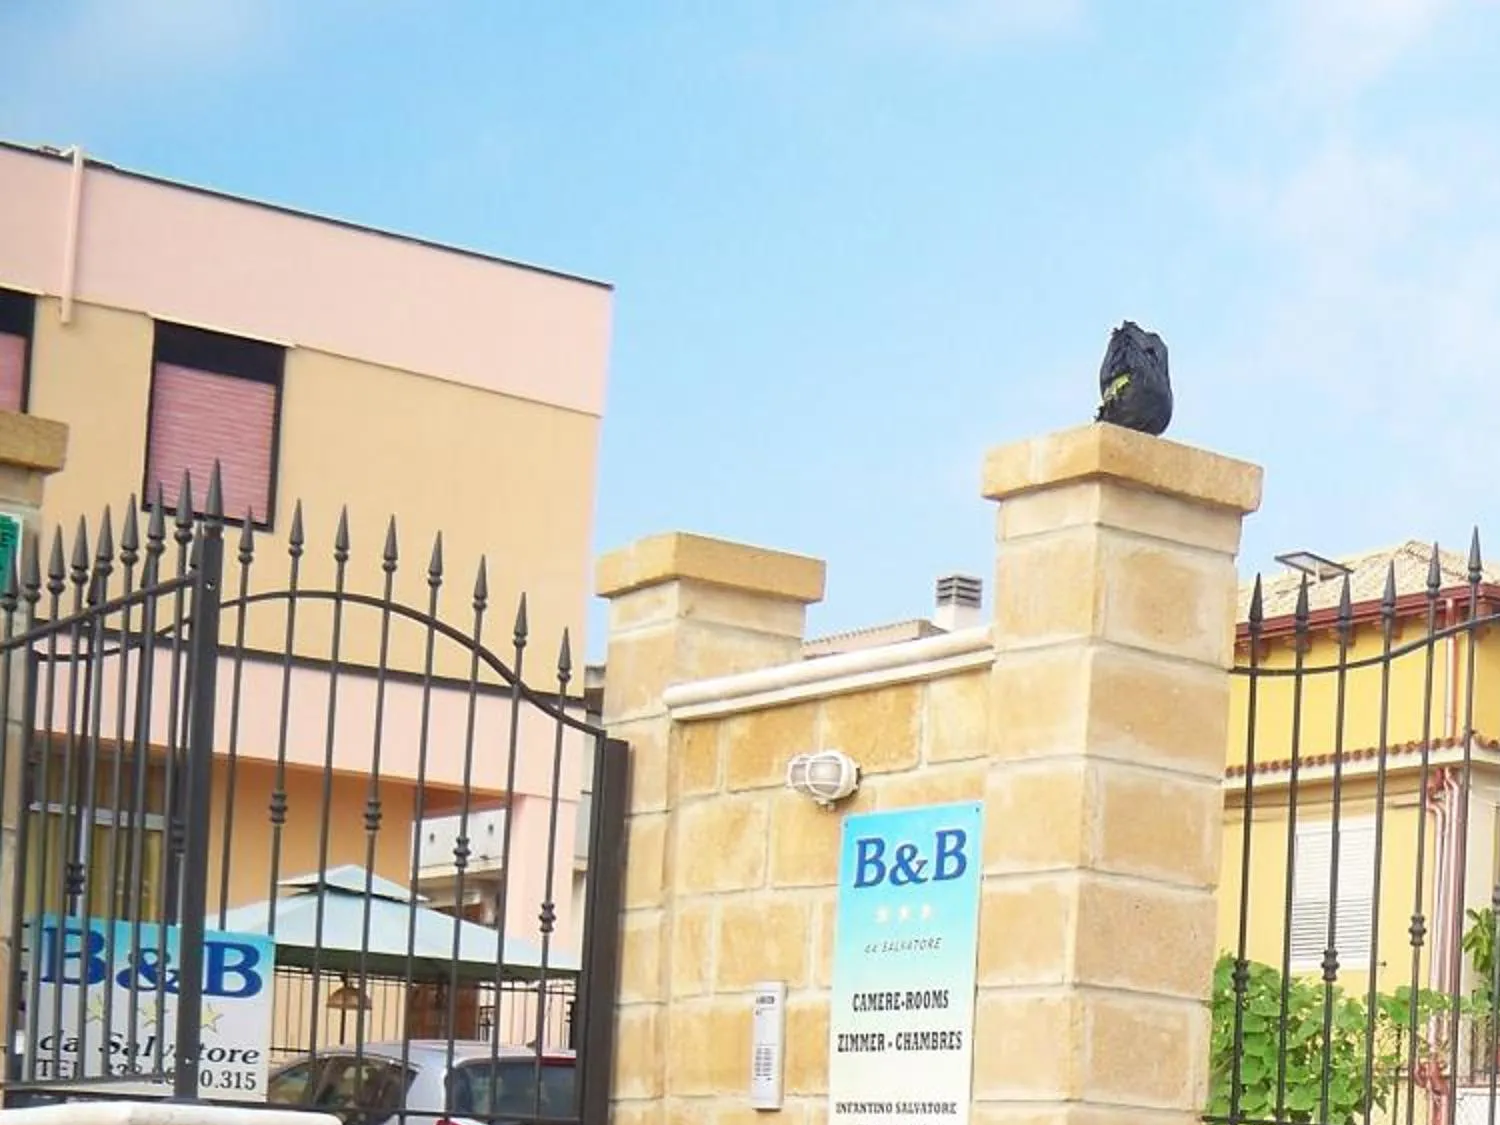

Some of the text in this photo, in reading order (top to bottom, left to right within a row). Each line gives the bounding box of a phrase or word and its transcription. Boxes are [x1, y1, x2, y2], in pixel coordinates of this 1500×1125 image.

[853, 828, 968, 889] B&B
[41, 926, 264, 999] B&B
[837, 1033, 885, 1052] ZIMMER
[895, 1031, 963, 1051] CHAMBRES
[895, 1101, 957, 1115] SALVATORE
